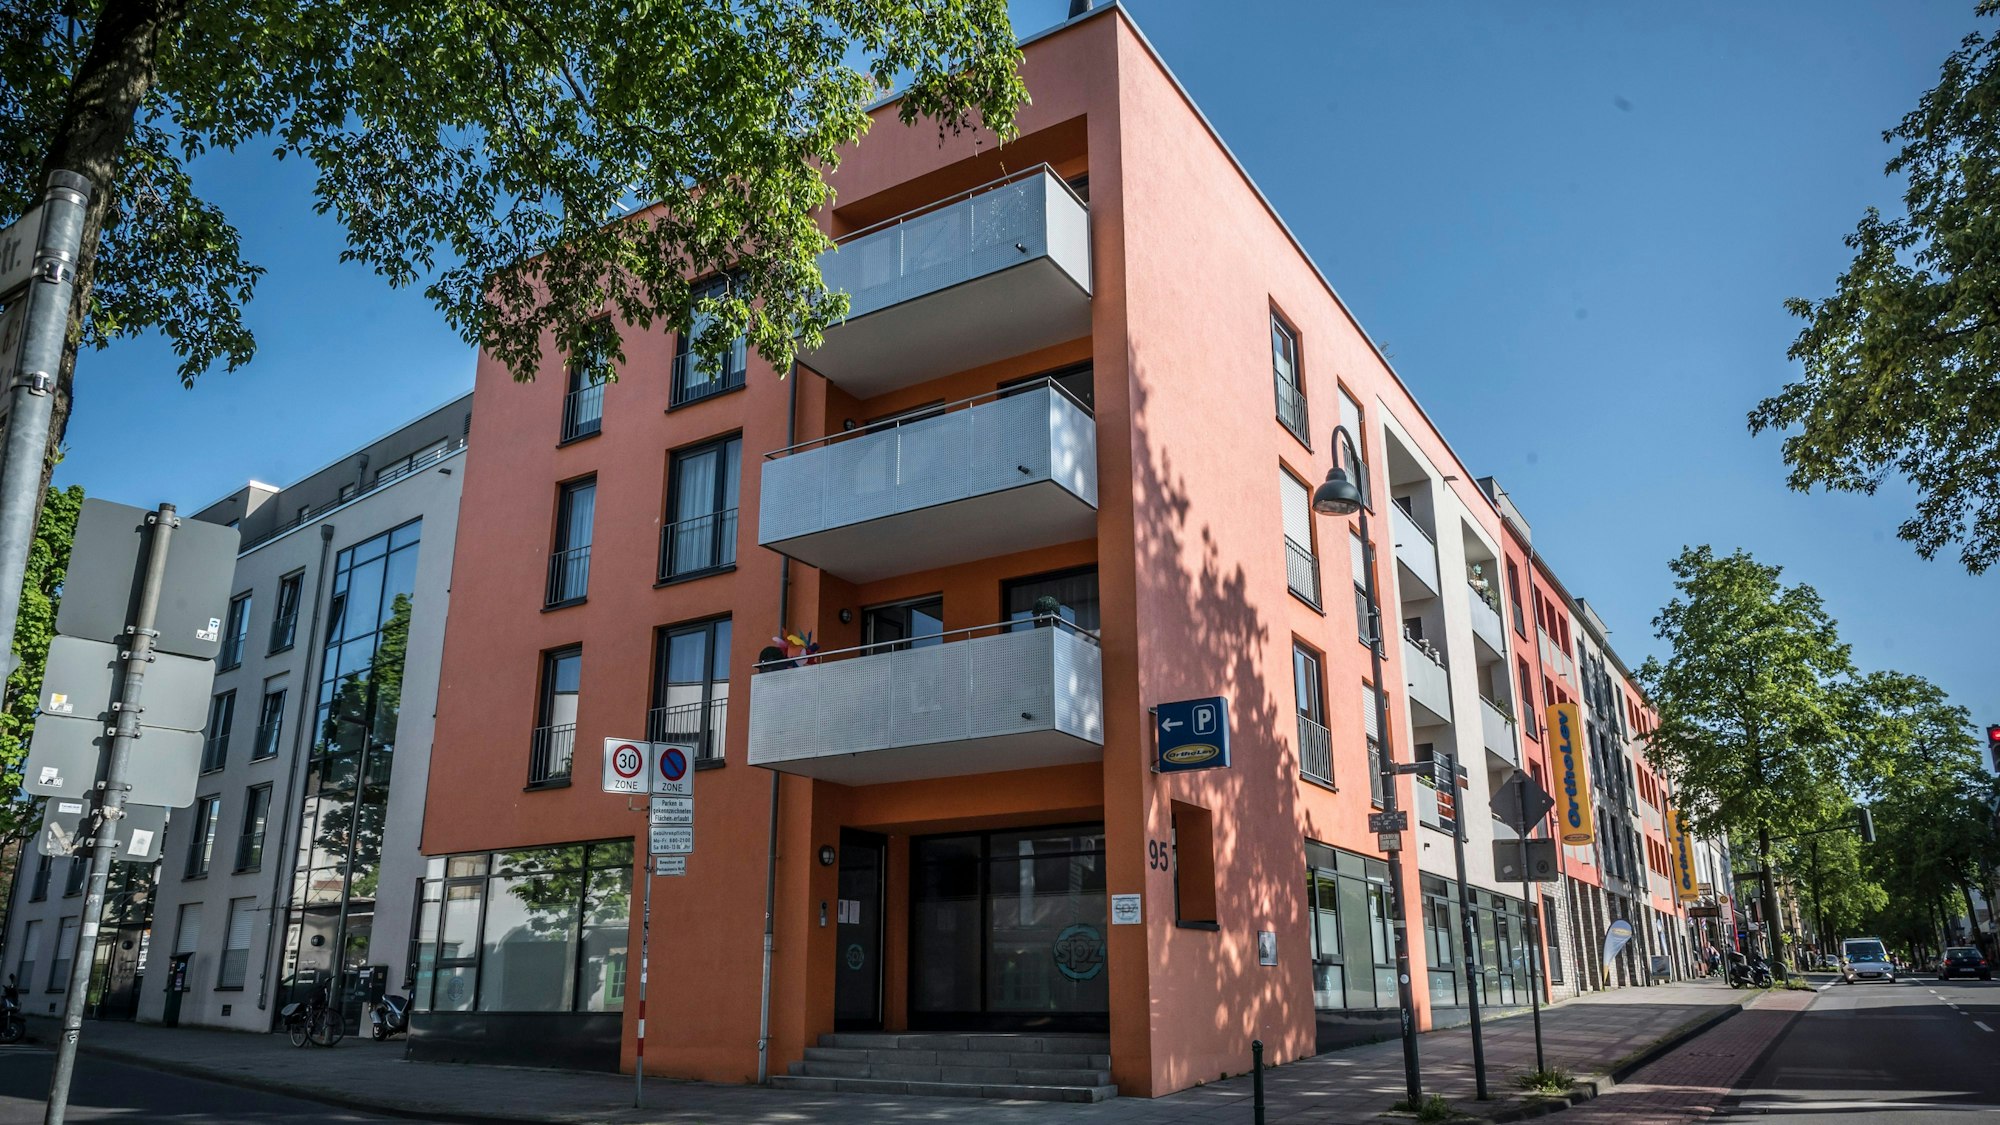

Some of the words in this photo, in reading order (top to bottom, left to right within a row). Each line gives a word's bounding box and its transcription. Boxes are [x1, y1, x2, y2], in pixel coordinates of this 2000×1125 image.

[0, 236, 22, 275] tr.
[1197, 708, 1212, 731] P
[619, 753, 637, 770] 30
[1168, 748, 1215, 758] OrthoLev
[1558, 709, 1581, 829] OrthoLev
[615, 780, 638, 790] ZONE
[662, 782, 683, 792] ZONE
[653, 807, 692, 815] gekennzeichneten
[1149, 839, 1169, 872] 95
[1055, 939, 1104, 970] spz
